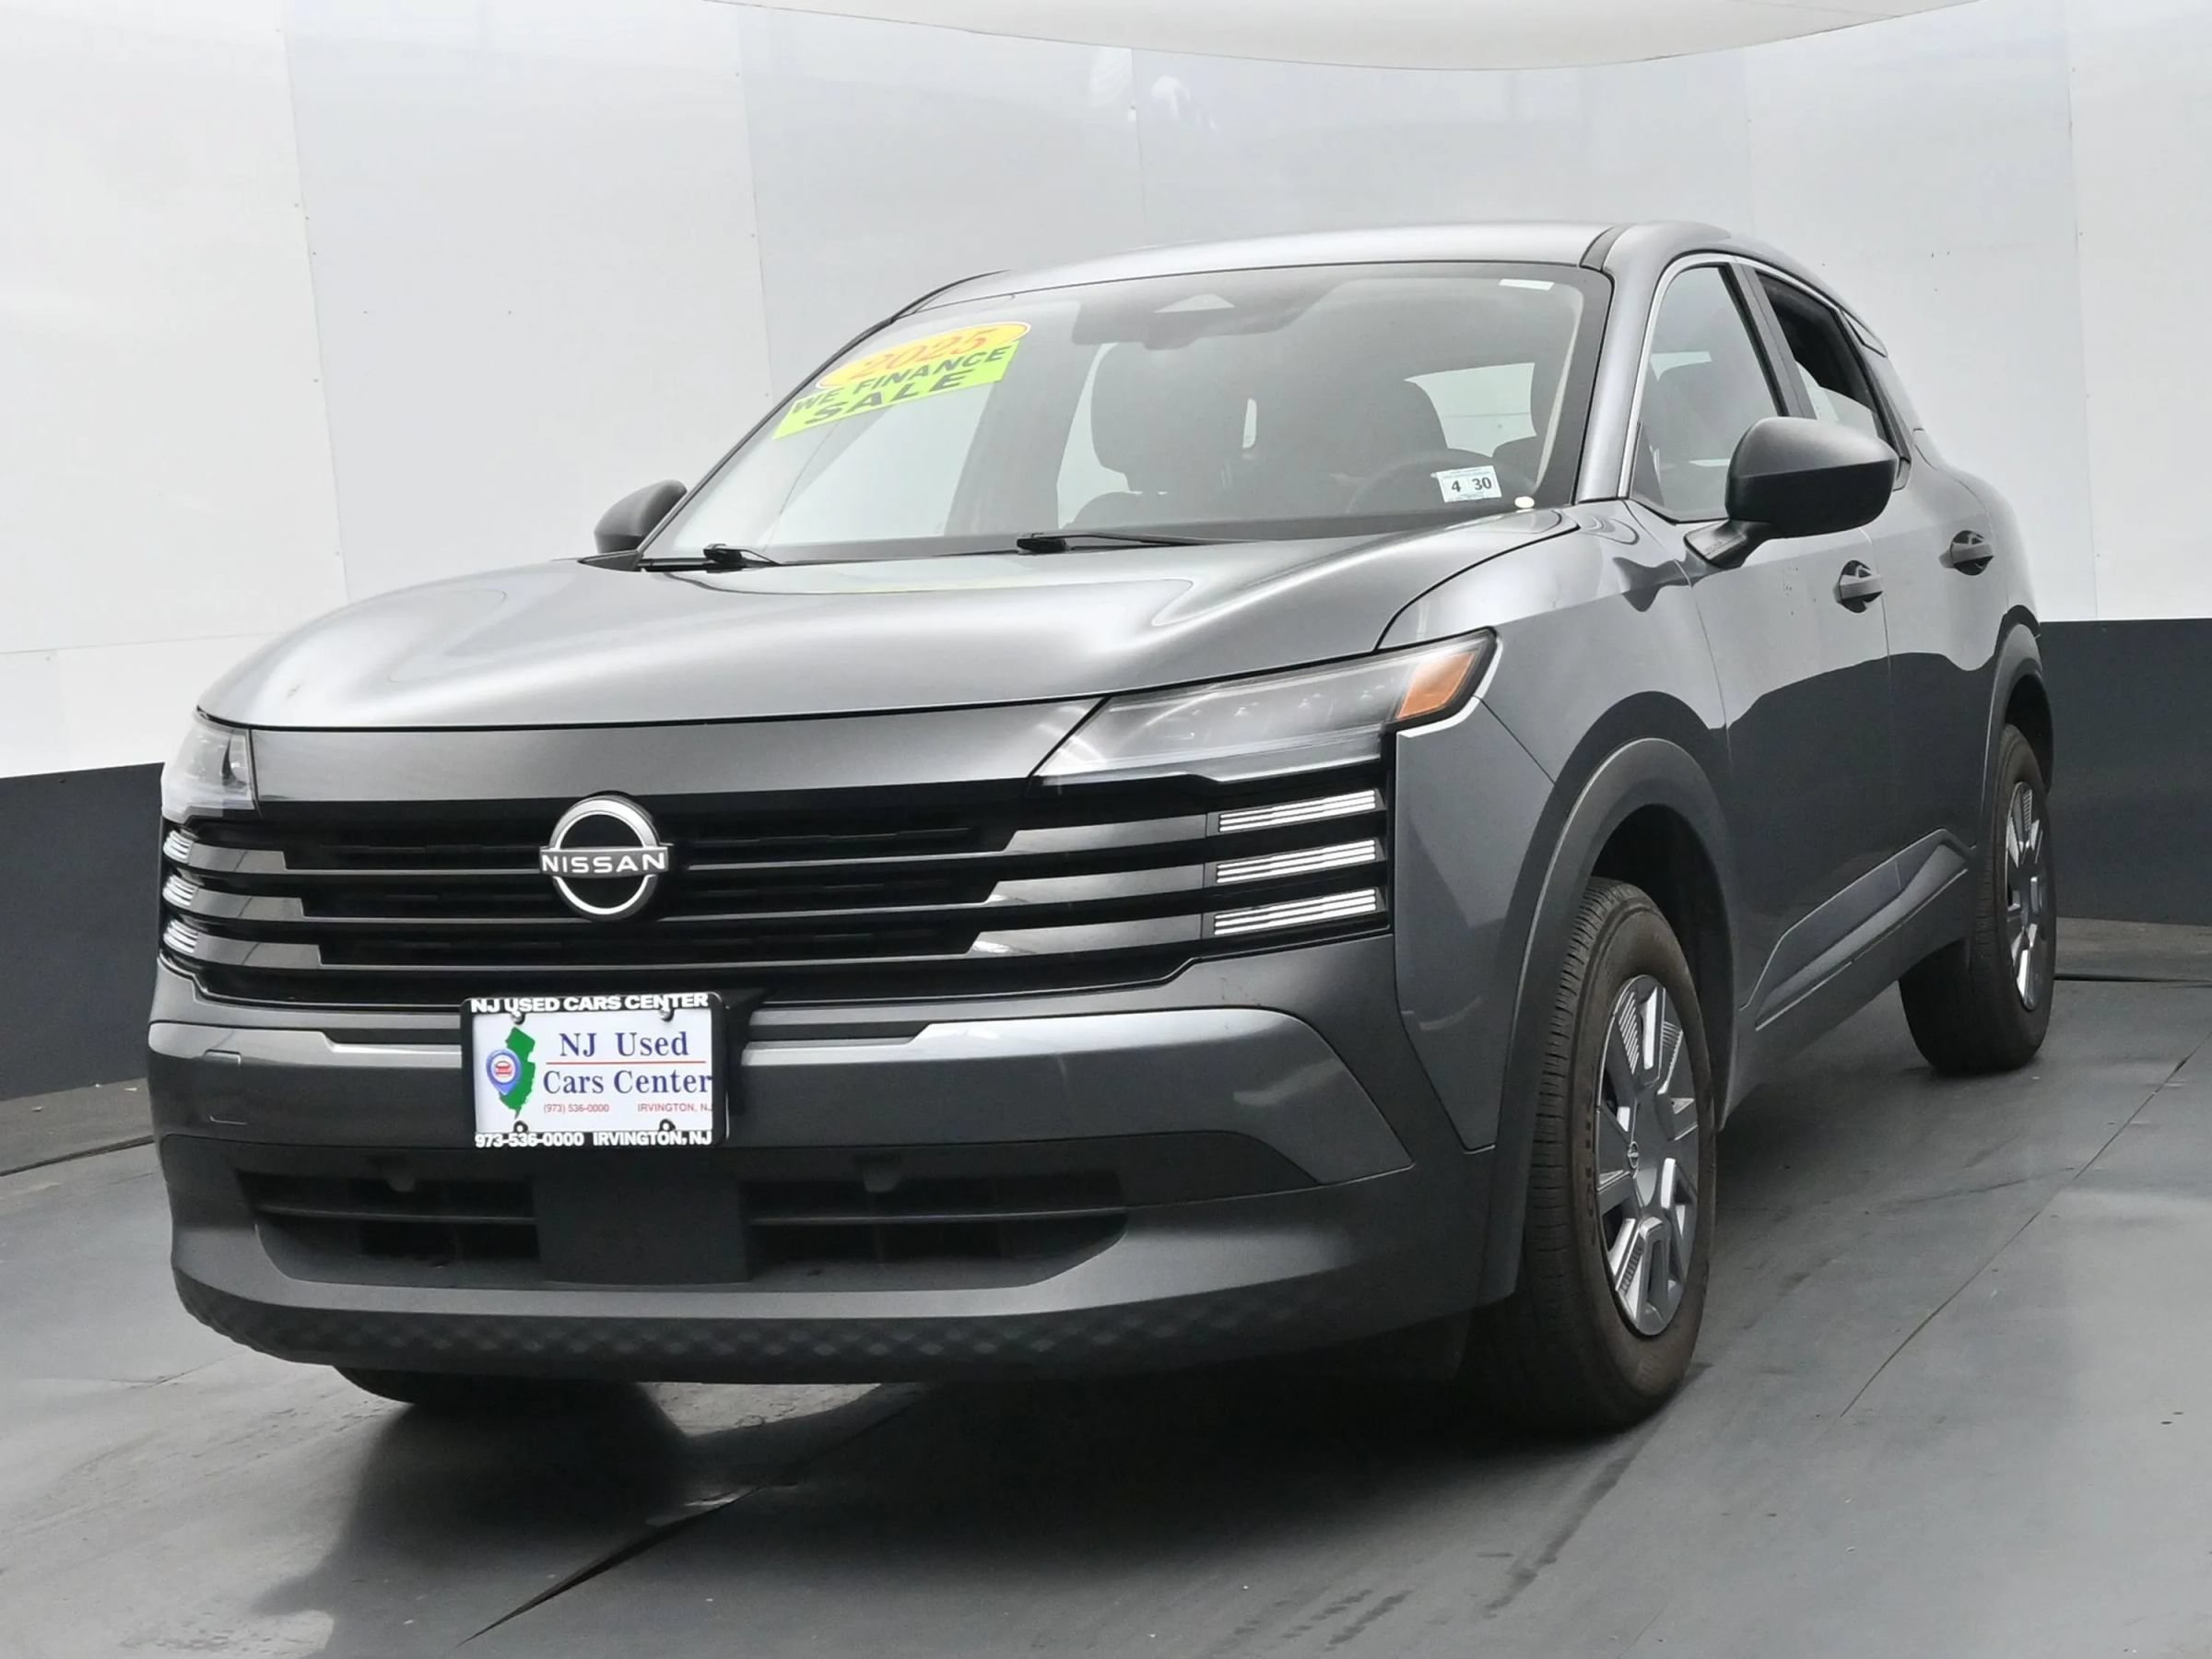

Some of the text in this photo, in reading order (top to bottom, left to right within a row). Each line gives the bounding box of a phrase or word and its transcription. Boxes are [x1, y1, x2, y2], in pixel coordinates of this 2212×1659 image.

[848, 327, 999, 381] 2025
[792, 346, 1012, 413] WE FINANCE
[804, 369, 975, 425] SALE
[1451, 477, 1492, 493] 4 30
[541, 852, 665, 874] NISSAN
[470, 993, 709, 1013] NJ USED CARS CENTER
[559, 1031, 688, 1057] NJ Used
[543, 1070, 712, 1094] Cars Center
[544, 1102, 566, 1113] (973)
[568, 1102, 609, 1113] 536-0000
[637, 1102, 698, 1113] IRVINGTON,
[475, 1130, 712, 1147] 973-536-0000 IRVINGTON, NJ
